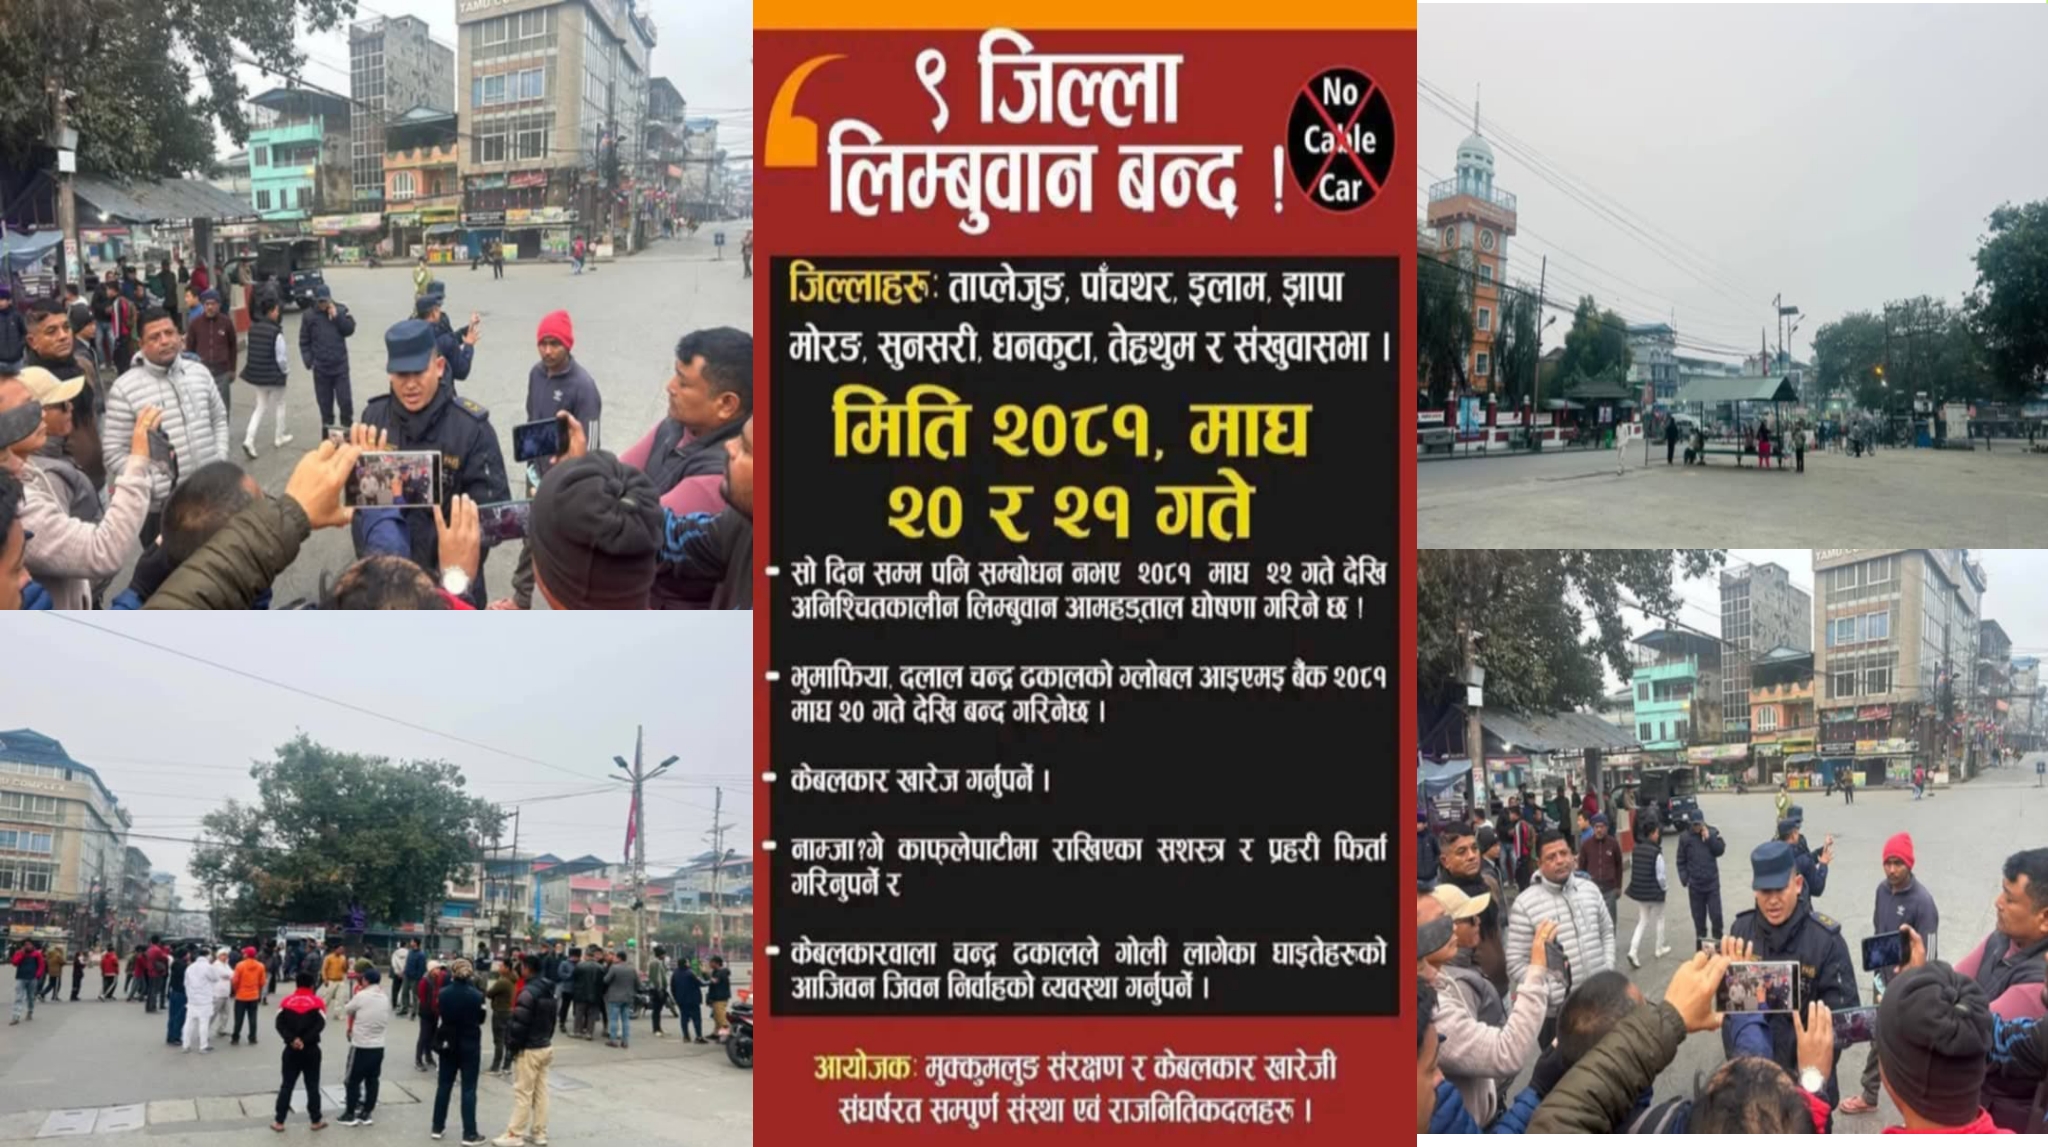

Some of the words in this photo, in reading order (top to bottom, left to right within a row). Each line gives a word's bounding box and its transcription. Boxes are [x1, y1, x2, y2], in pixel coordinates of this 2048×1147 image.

[916, 48, 949, 132] ९
[978, 27, 1184, 128] जिल्ला
[1323, 77, 1359, 106] No
[1304, 123, 1377, 154] Cable
[827, 118, 1098, 236] लिम्बुवान
[1118, 145, 1243, 220] बन्द
[1319, 173, 1363, 202] Car
[949, 263, 1070, 310] ताप्लेजुङ,
[1081, 262, 1178, 305] पाँचथर,
[1189, 272, 1272, 308] इलाम,
[1283, 272, 1346, 308] झापा
[789, 322, 867, 364] मोरङ,
[877, 322, 982, 370] सुनसरी,
[992, 332, 1098, 370] धनकुटा,
[1205, 332, 1226, 364] र
[1233, 325, 1371, 370] संखुवासभा
[832, 384, 972, 460] मिति
[993, 404, 1165, 462] २०८१,
[1190, 404, 1313, 458] माघ
[888, 485, 963, 539] २०
[988, 485, 1035, 543] र
[1053, 485, 1129, 539] २१
[1154, 467, 1257, 542] गते
[790, 555, 817, 586] सो
[824, 555, 865, 586] दिन
[873, 562, 922, 587] सम्म
[930, 555, 970, 585] पनि
[978, 555, 1064, 587] सम्बोधन
[1071, 562, 1122, 585] नभए
[1137, 562, 1191, 585] २०८१
[1208, 561, 1250, 585] माघ
[1266, 562, 1293, 585] २२
[1301, 555, 1335, 586] गते
[1343, 555, 1388, 586] देखि
[791, 589, 960, 621] अनिश्चितकालीन
[966, 589, 1059, 625] लिम्बुवान
[1190, 590, 1258, 620] घोषणा
[1263, 589, 1321, 620] गरिने
[1326, 596, 1349, 620] छ
[899, 665, 964, 690] दलाल
[969, 665, 1015, 692] चन्द्र
[1019, 658, 1114, 690] ढकालको
[1119, 659, 1194, 690] ग्लोबल
[1199, 665, 1287, 692] आइएमइ
[1333, 665, 1387, 689] २०८१
[791, 699, 832, 723] माघ
[838, 700, 865, 723] २०
[872, 693, 907, 724] गते
[912, 692, 958, 725] देखि
[963, 700, 1007, 724] बन्द
[1012, 692, 1091, 724] गरिनेछ
[790, 762, 891, 793] केबलकार
[896, 762, 960, 793] खारेज
[1052, 830, 1144, 862] राखिएका
[1156, 838, 1226, 863] सशस्त्र
[1239, 838, 1255, 862] र
[1268, 831, 1321, 864] प्रहरी
[1333, 830, 1388, 862] फिर्ता
[790, 866, 881, 903] गरिनुपर्ने
[886, 873, 902, 897] र
[790, 935, 938, 966] केबलकारवाला
[952, 942, 999, 968] चन्द्र
[1012, 934, 1101, 966] ढकालले
[1115, 934, 1169, 966] गोली
[1183, 935, 1257, 966] लागेका
[791, 969, 877, 1000] आजिवन
[882, 969, 941, 1000] जिवन
[947, 969, 1036, 1002] निर्वाहको
[1041, 976, 1119, 1001] व्यवस्था
[1046, 1050, 1125, 1083] संरक्षण
[1131, 1055, 1148, 1082] र
[1153, 1048, 1258, 1082] केबलकार
[1263, 1047, 1338, 1082] खारेजी
[838, 1091, 923, 1125] संघर्षरत
[929, 1091, 1000, 1130] सम्पुर्ण
[1006, 1093, 1066, 1125] संस्था
